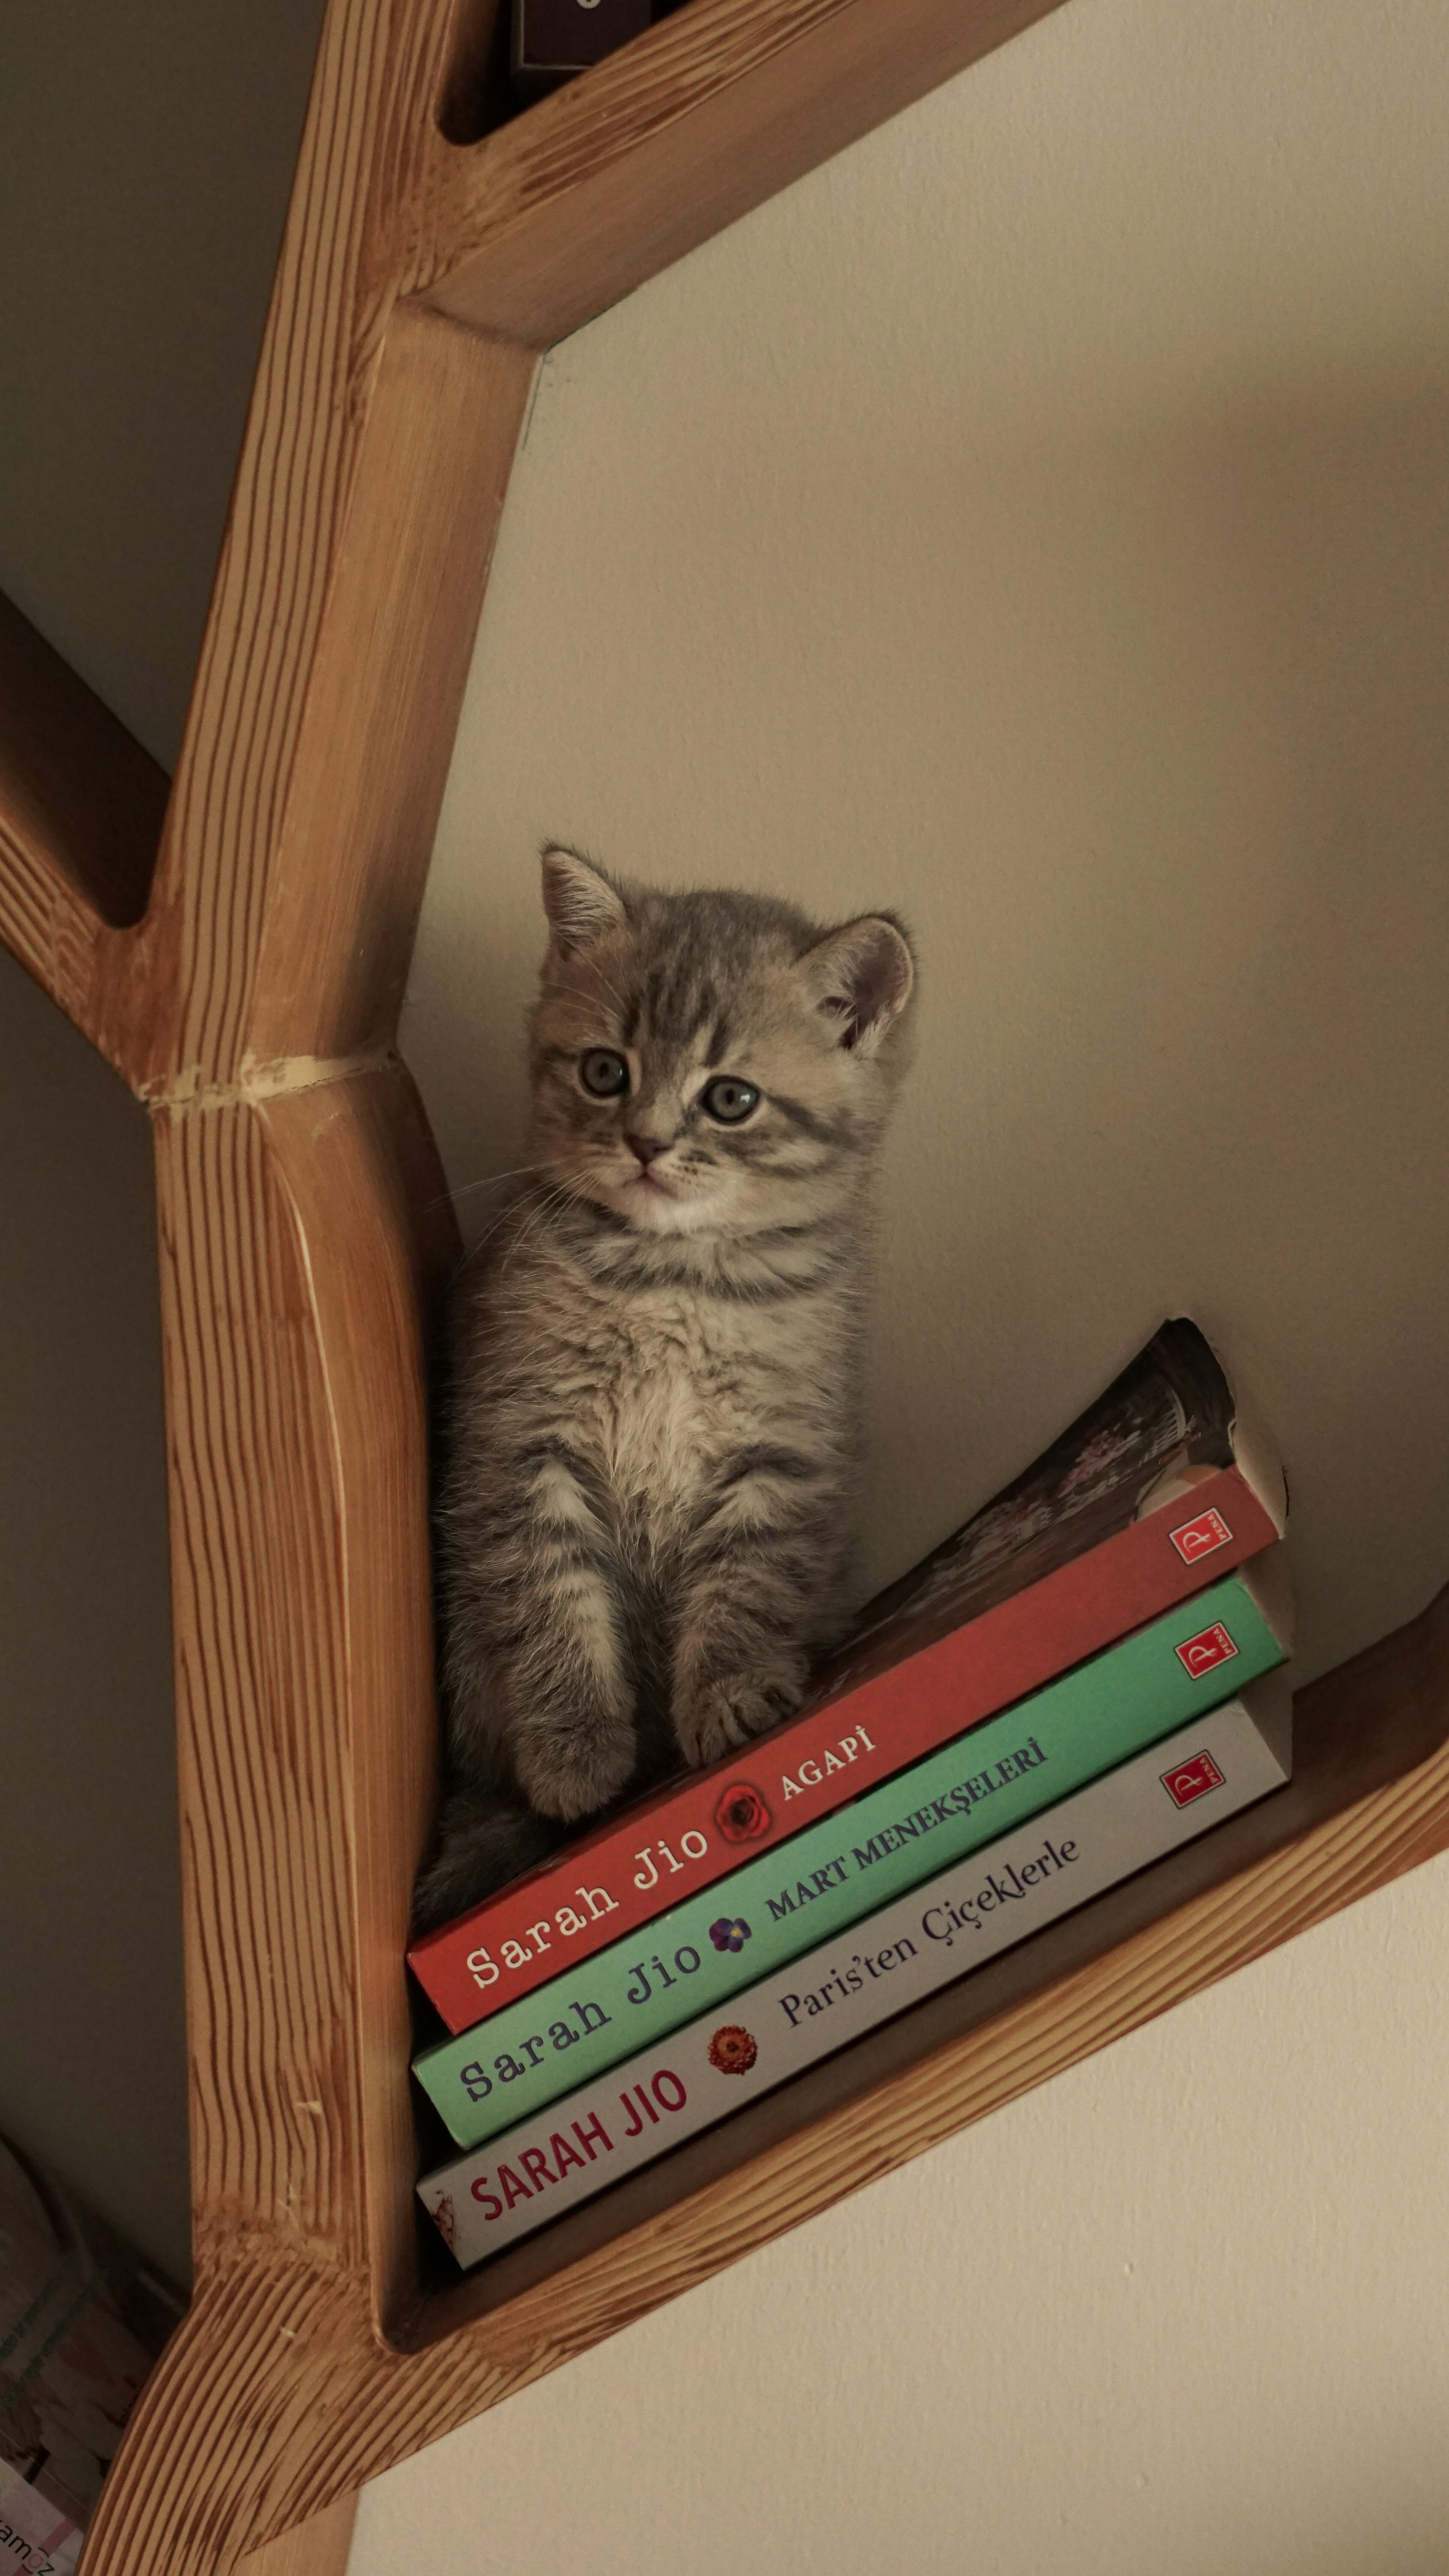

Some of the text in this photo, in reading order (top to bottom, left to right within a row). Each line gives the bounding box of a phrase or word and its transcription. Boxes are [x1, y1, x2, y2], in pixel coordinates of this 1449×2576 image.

[1207, 1513, 1227, 1540] PENA
[1213, 1628, 1233, 1655] PENA
[1200, 1757, 1219, 1784] PENA
[460, 1737, 1049, 2102] Sarah Jio MART MENEKŞELERİ
[466, 1725, 876, 1989] Sarah Jio AGAPİ
[471, 1838, 1080, 2221] SARAH JIO Paris'ten Çiçeklerle
